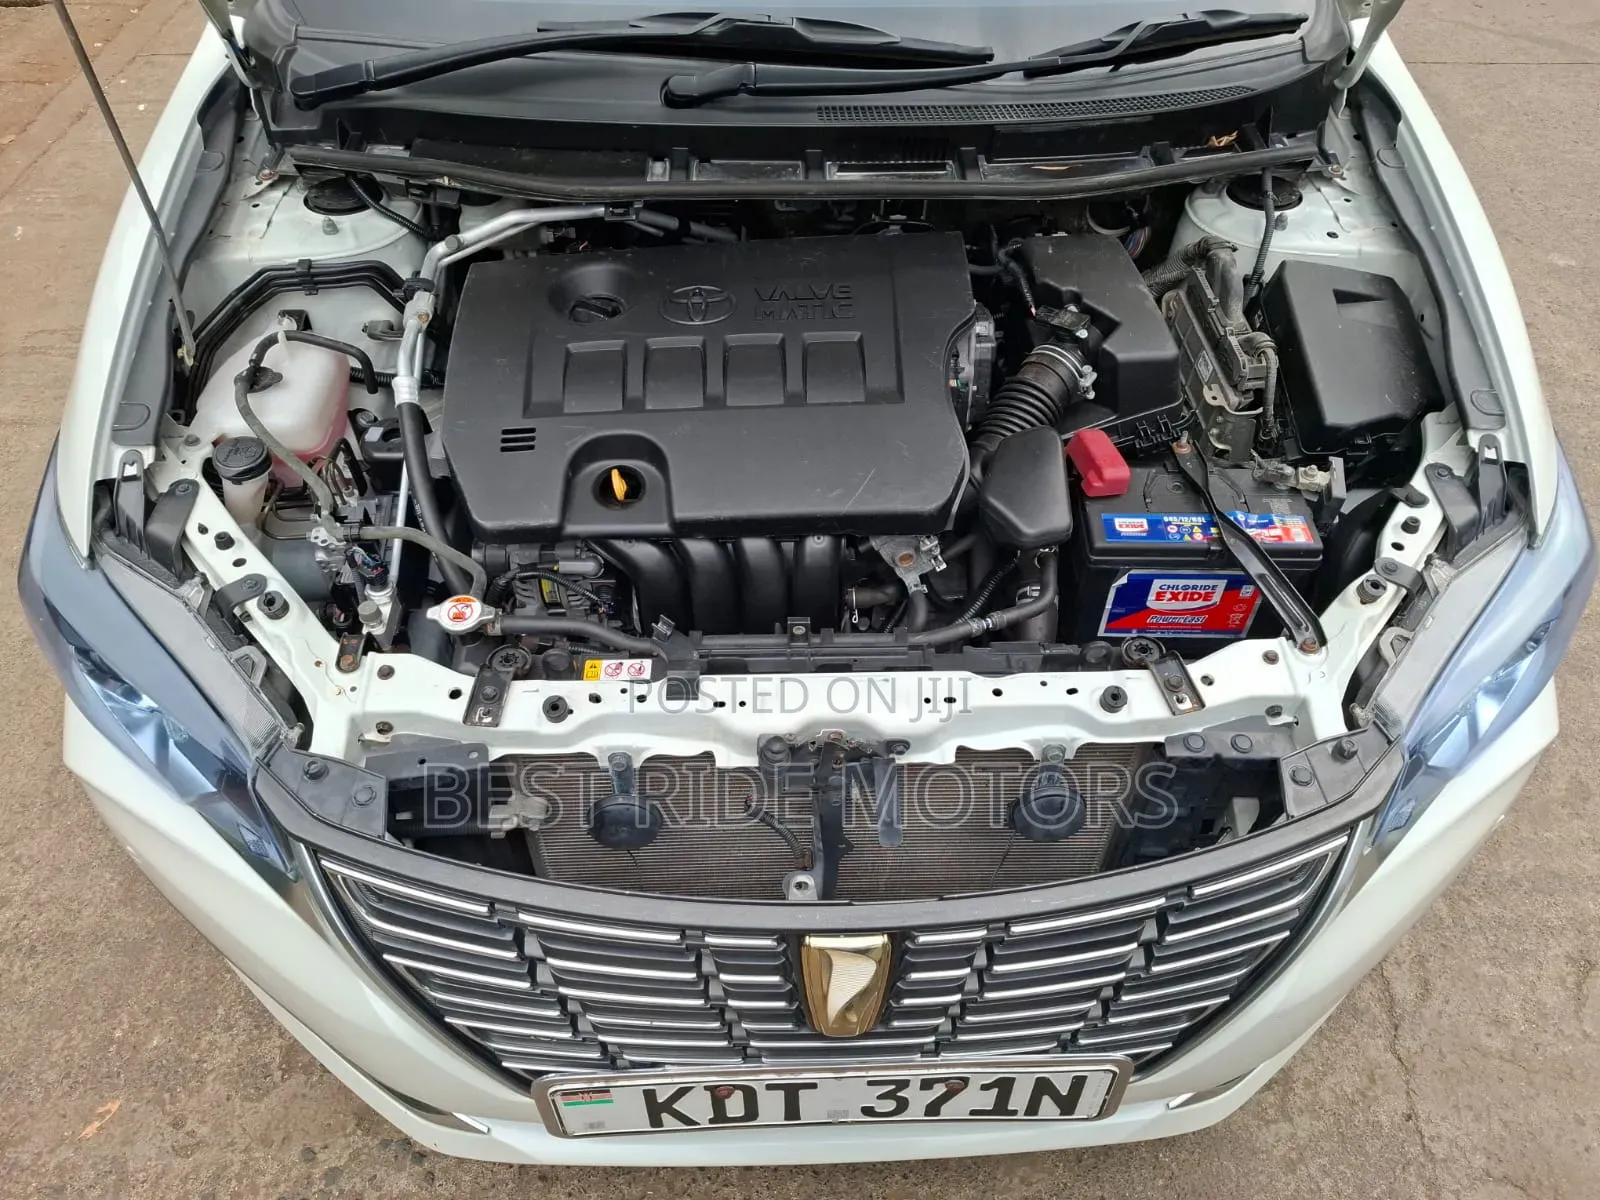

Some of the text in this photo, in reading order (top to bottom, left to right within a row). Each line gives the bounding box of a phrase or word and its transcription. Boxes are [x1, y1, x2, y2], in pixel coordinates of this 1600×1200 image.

[754, 284, 852, 302] VALVE
[1155, 591, 1216, 602] EXIDE
[643, 1082, 818, 1128] KDT
[860, 1074, 1088, 1118] 371N
